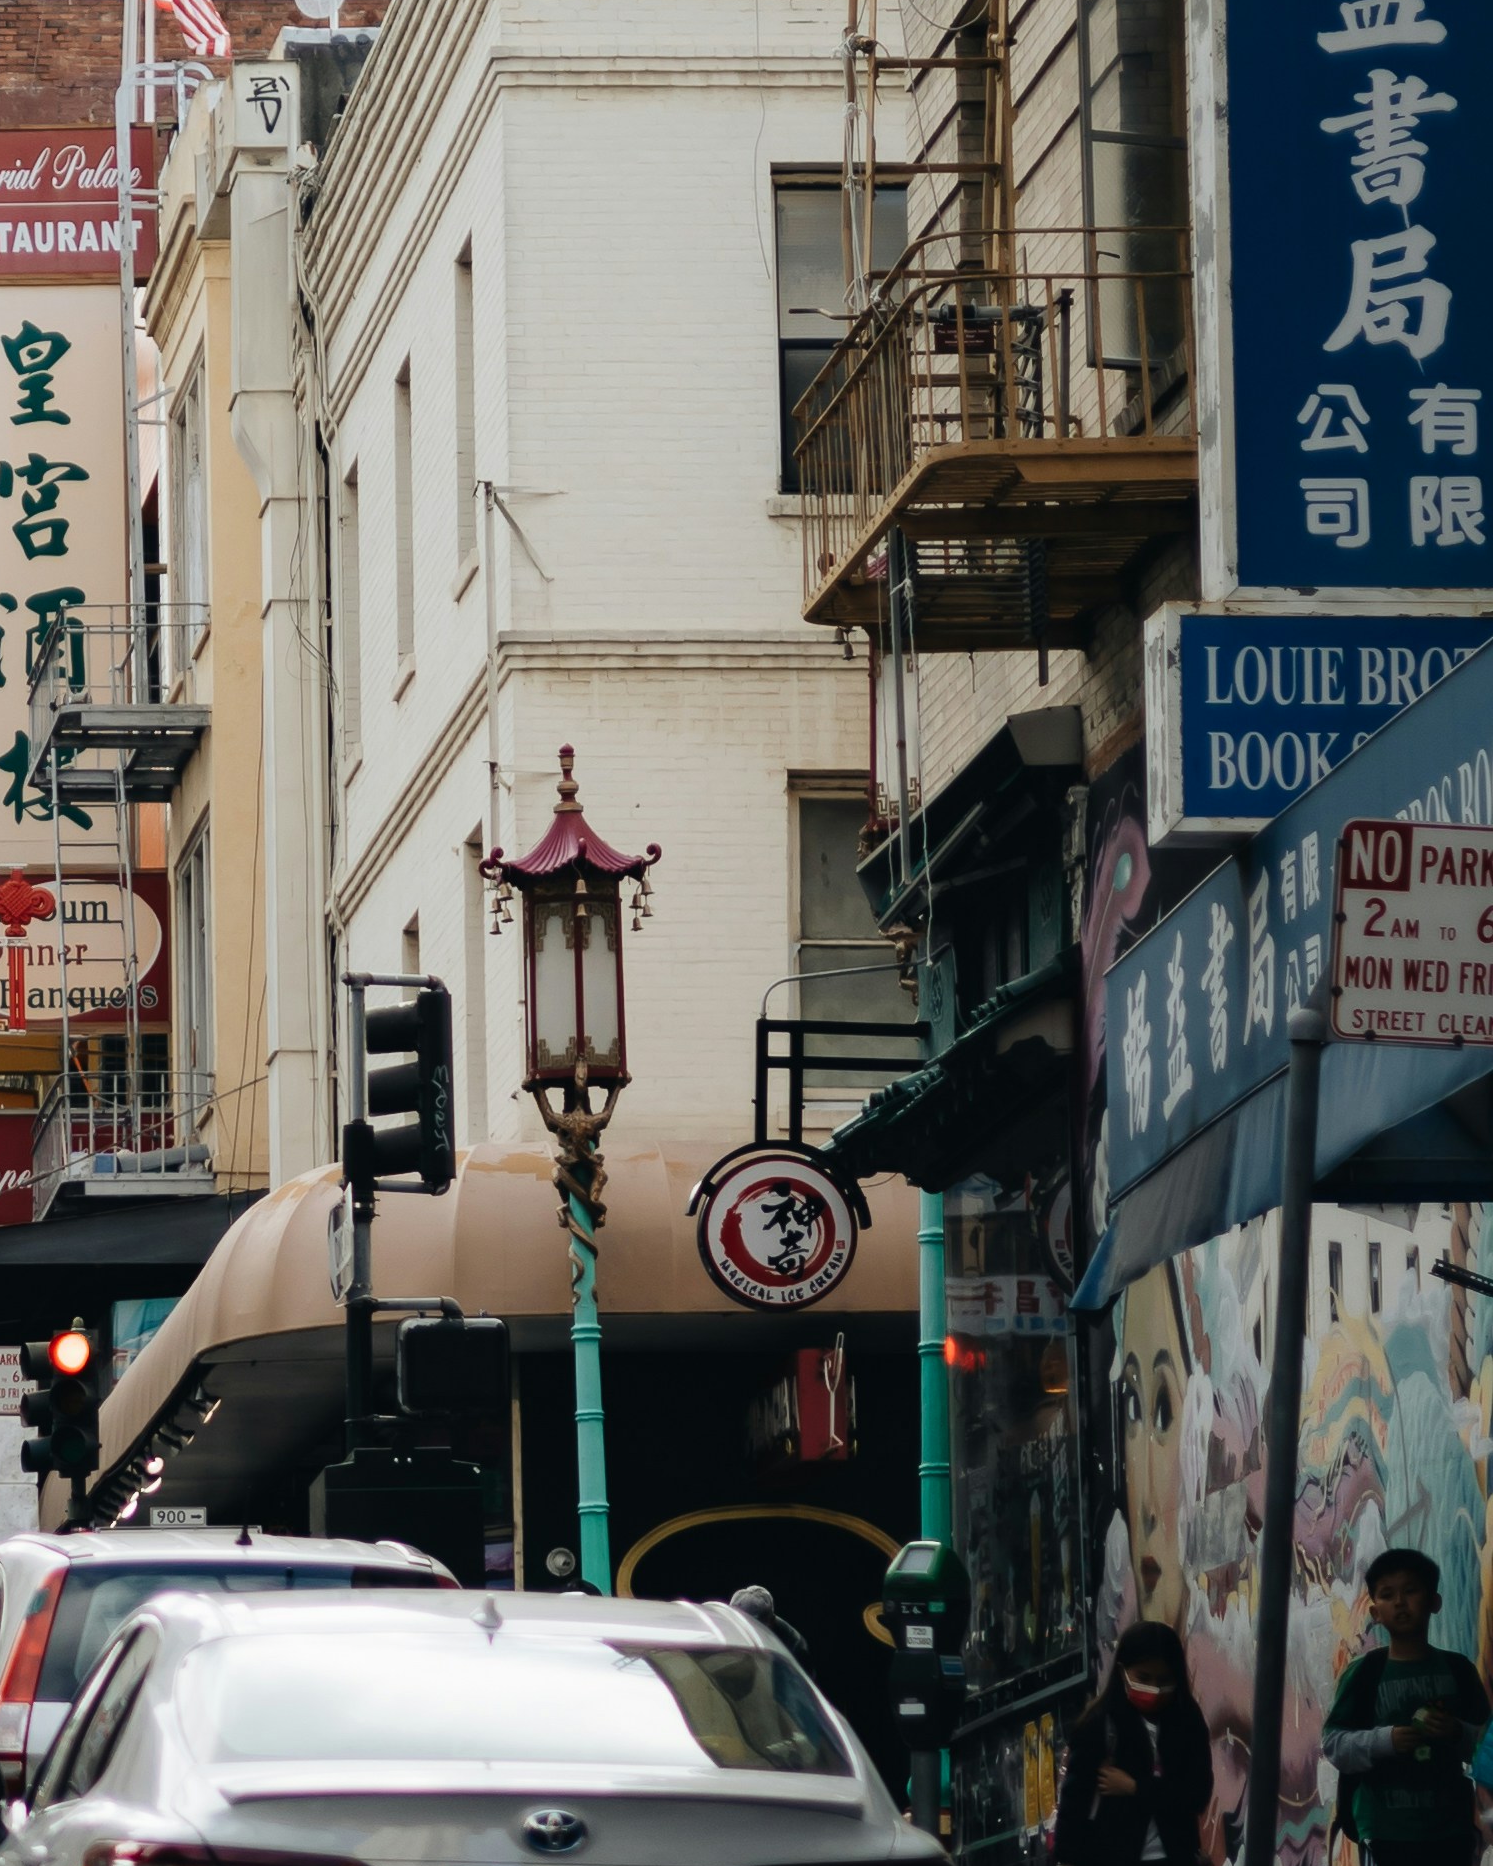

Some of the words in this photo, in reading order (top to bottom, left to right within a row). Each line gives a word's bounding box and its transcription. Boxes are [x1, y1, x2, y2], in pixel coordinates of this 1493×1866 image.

[51, 144, 142, 190] Palae
[1203, 644, 1346, 706] LOUIE
[1207, 731, 1335, 791] BOOK
[1349, 829, 1403, 883] NO
[1439, 926, 1457, 941] TO
[1345, 956, 1393, 990] MON
[1403, 960, 1450, 993] WED
[1351, 1009, 1426, 1032] STREET
[719, 1259, 774, 1301] MAGICAL
[781, 1288, 805, 1303] ICE
[810, 1252, 844, 1295] CREAM
[8, 1387, 20, 1399] FRI
[156, 1510, 187, 1524] 900
